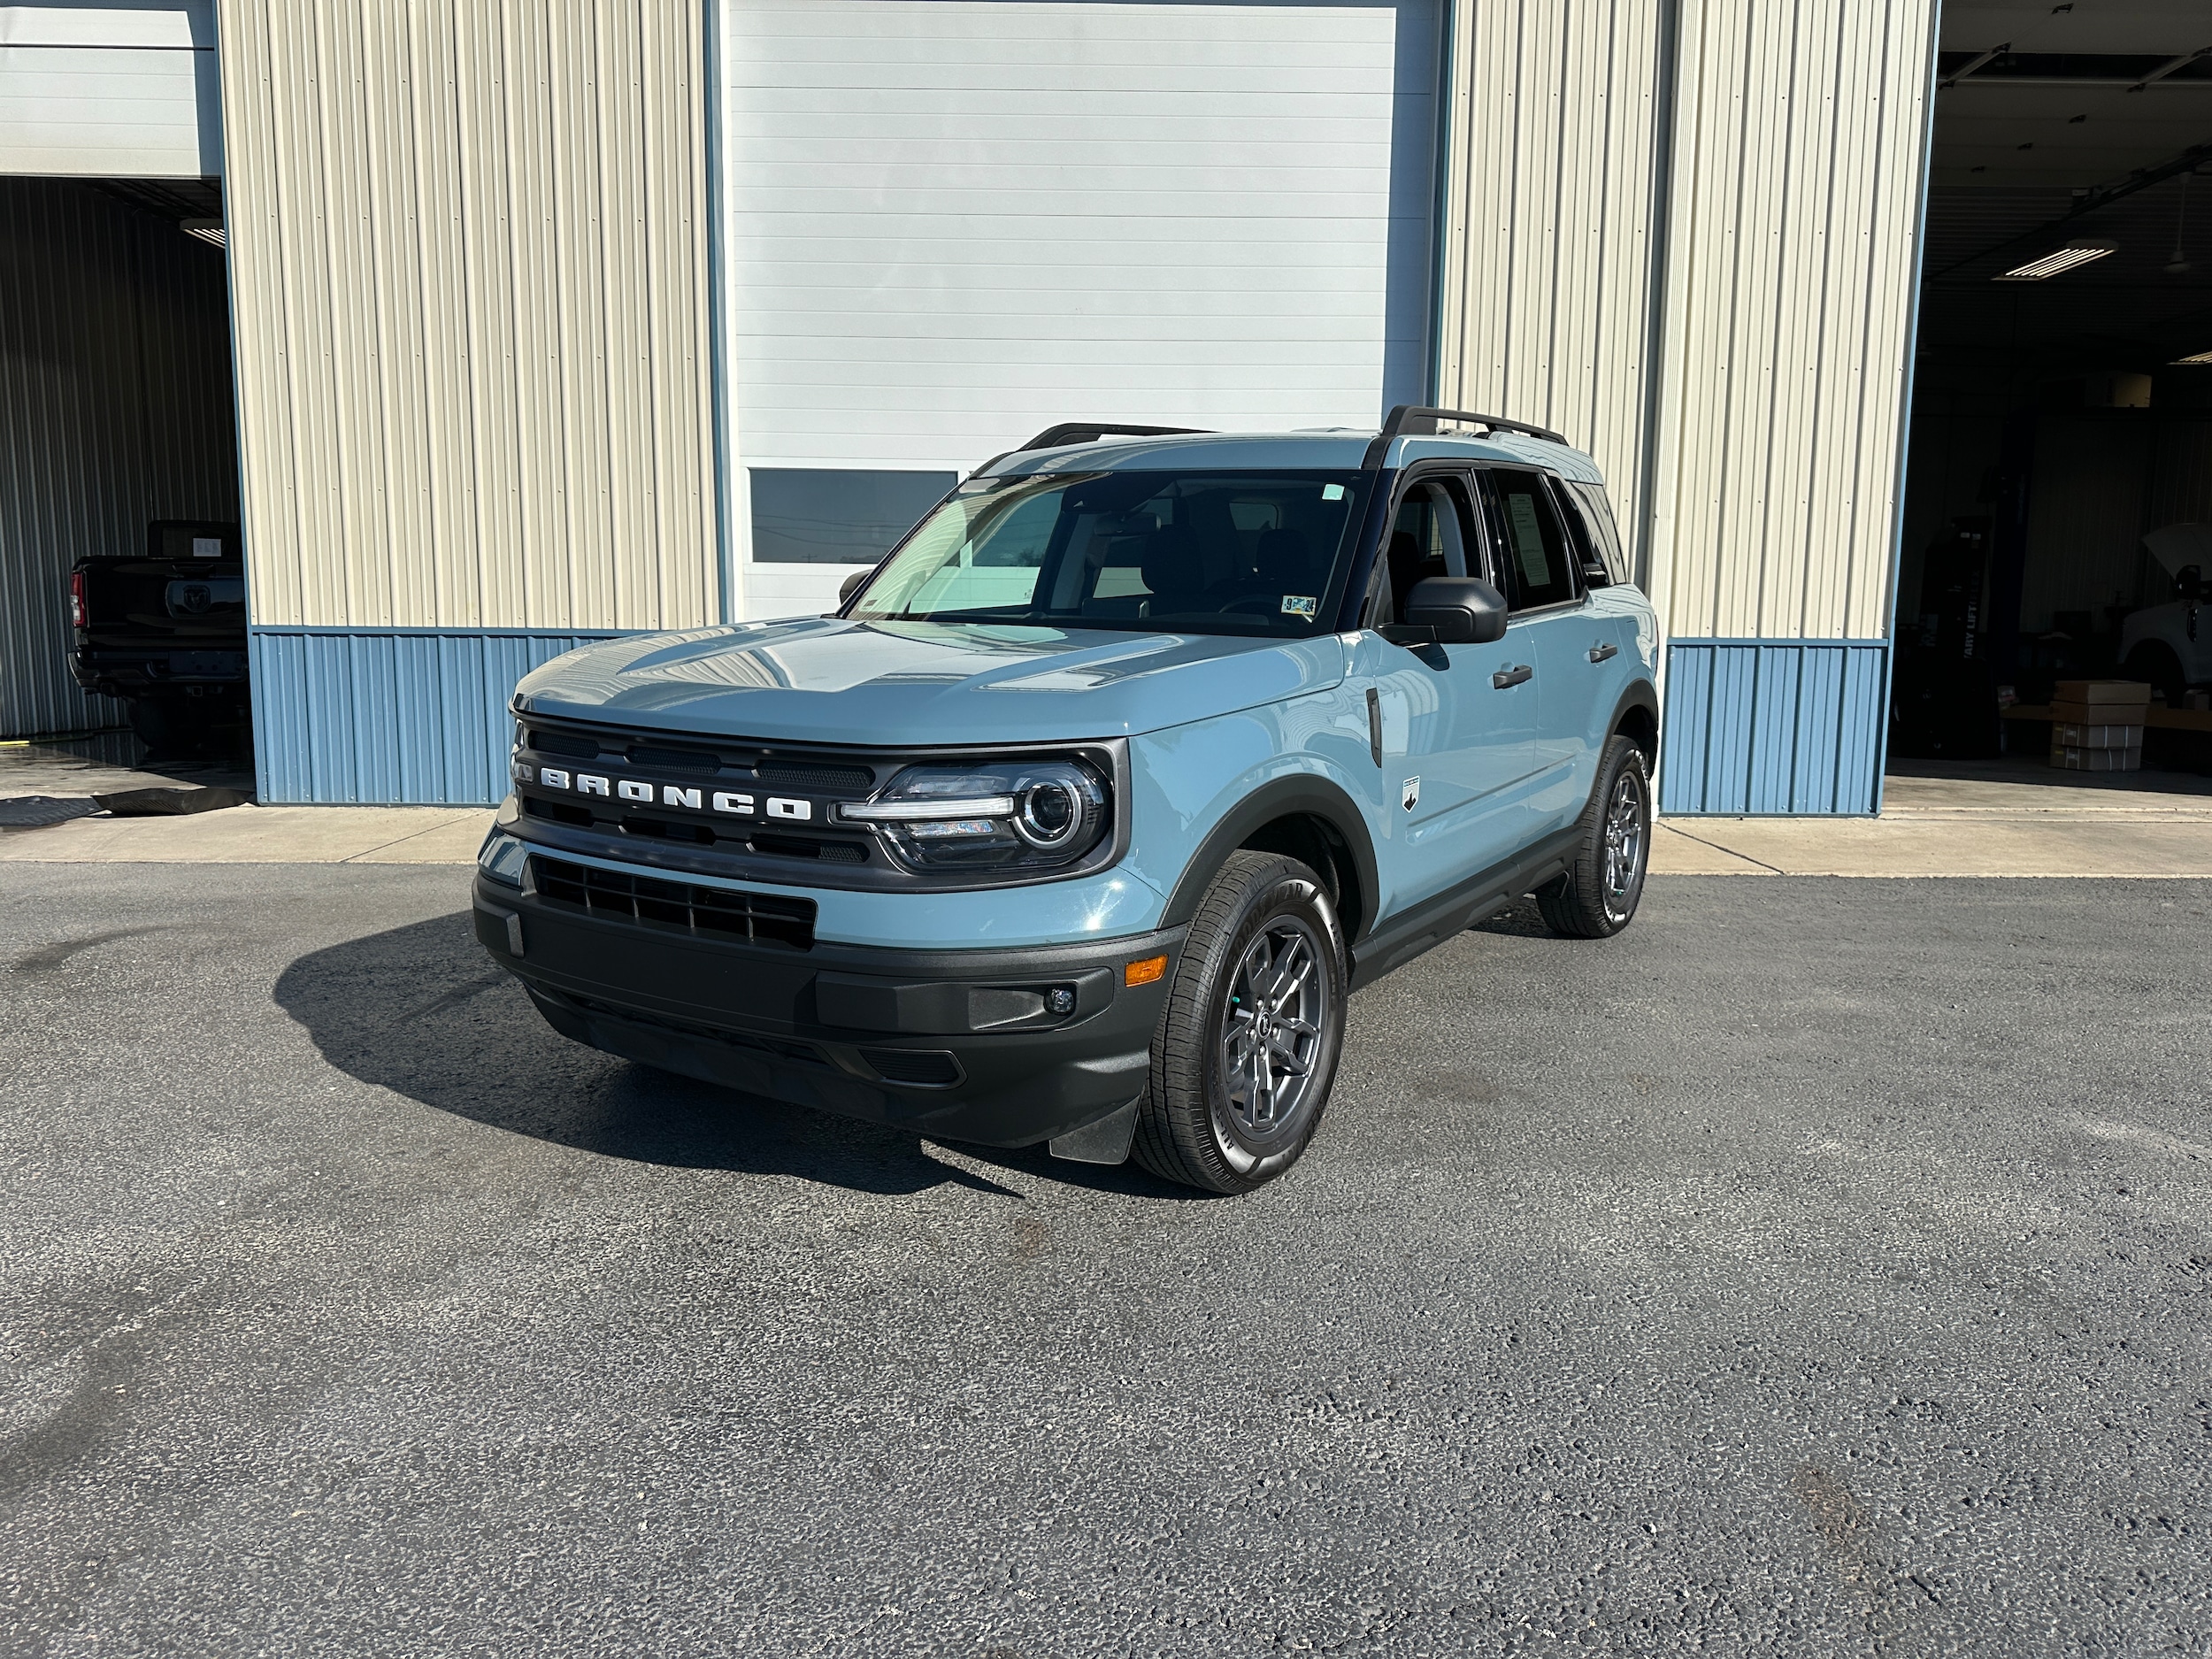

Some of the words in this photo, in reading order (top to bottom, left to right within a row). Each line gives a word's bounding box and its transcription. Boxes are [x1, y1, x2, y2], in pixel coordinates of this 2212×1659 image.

[1286, 597, 1293, 611] 9
[1304, 599, 1315, 613] 24
[1966, 604, 1978, 629] LIFT
[1962, 632, 1975, 658] ARY
[540, 766, 812, 821] BRONCO
[1225, 881, 1303, 970] GOODYEAR
